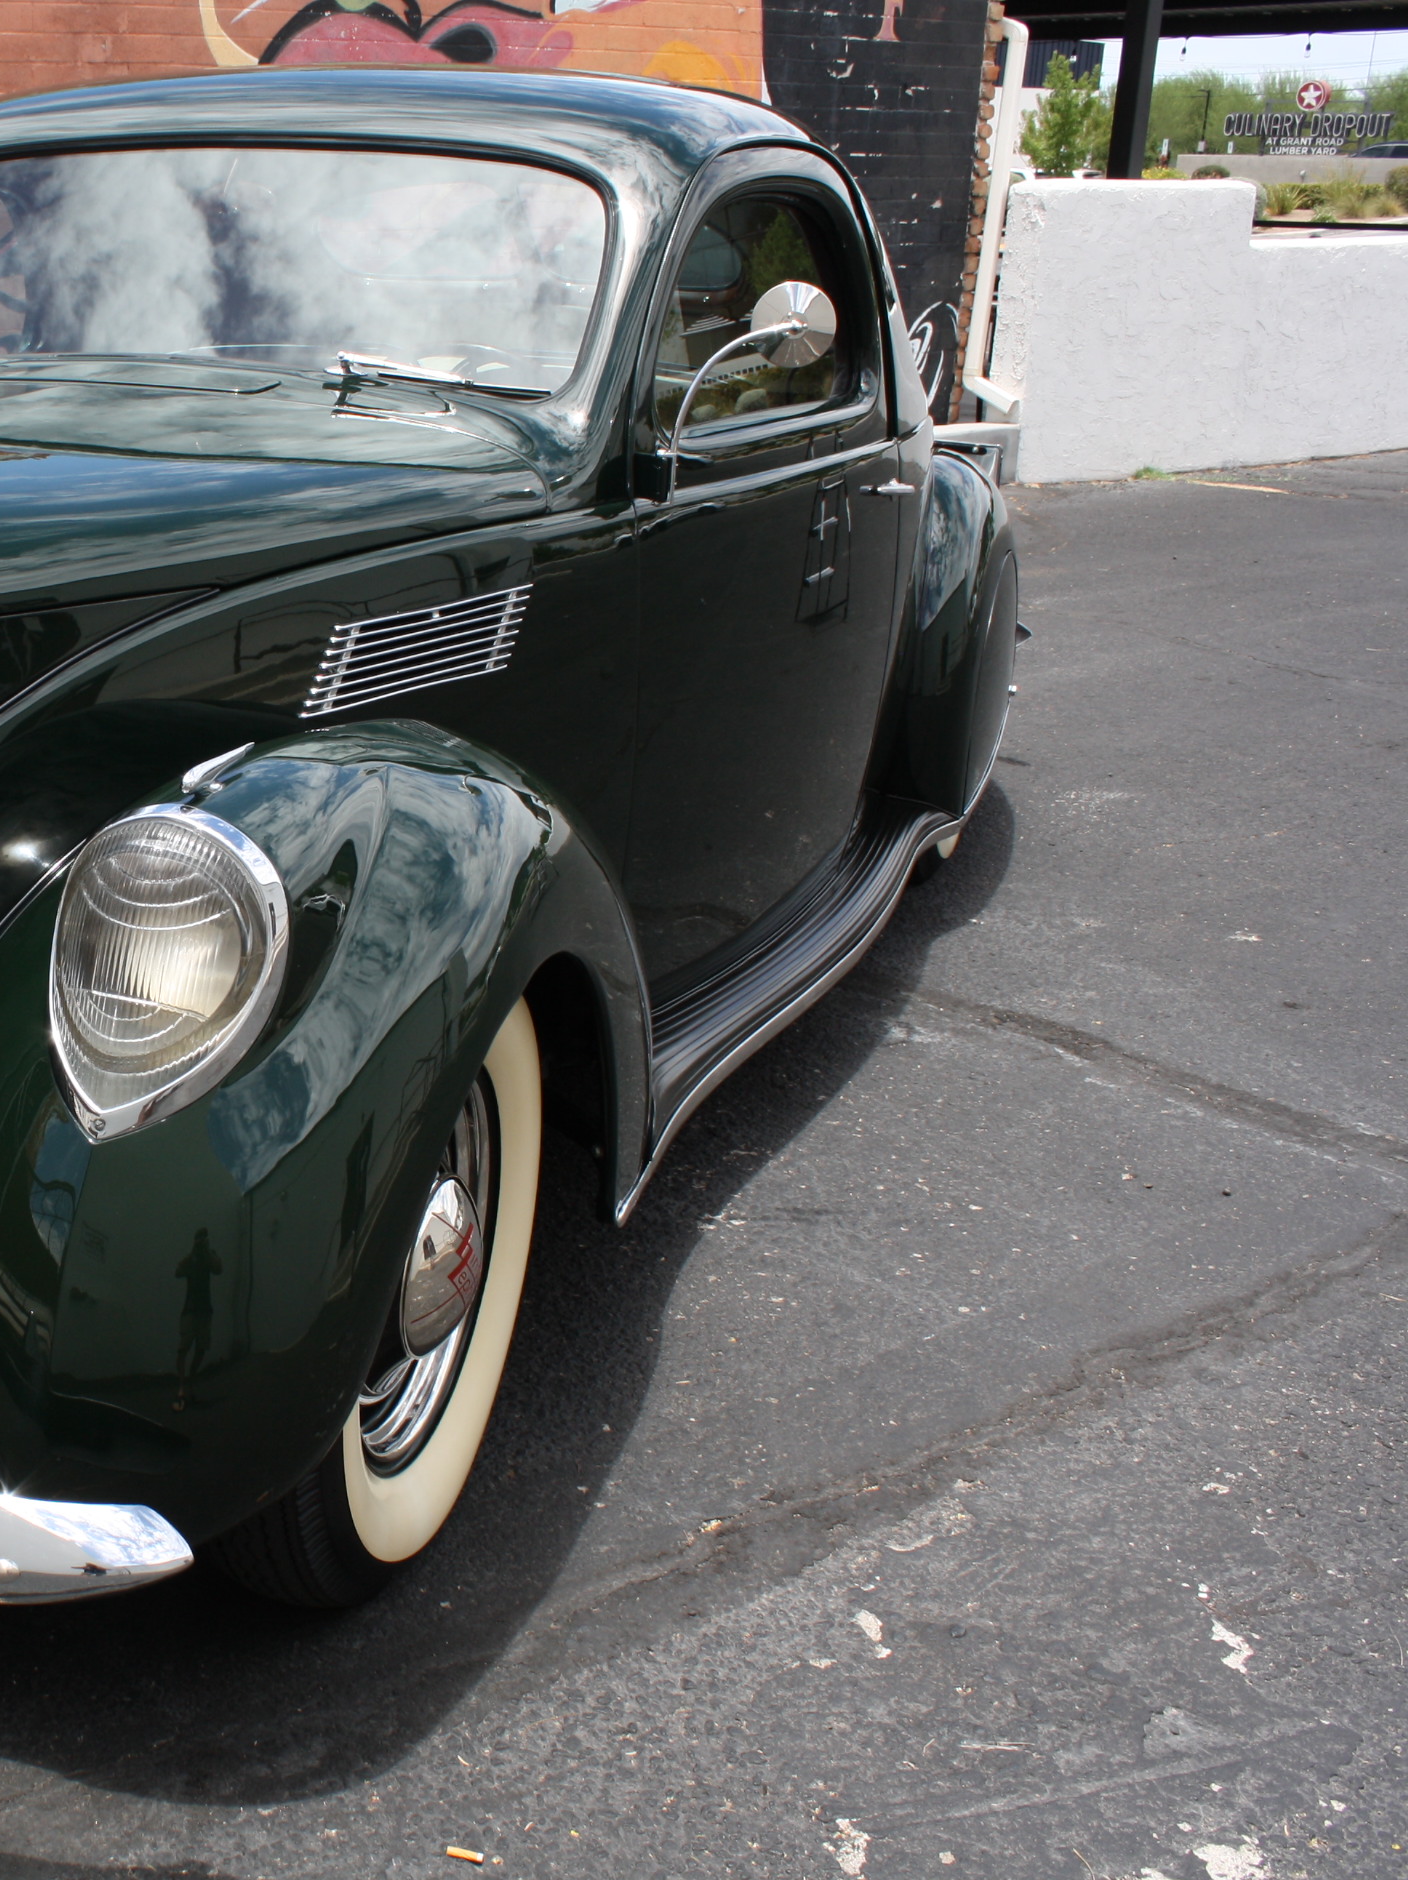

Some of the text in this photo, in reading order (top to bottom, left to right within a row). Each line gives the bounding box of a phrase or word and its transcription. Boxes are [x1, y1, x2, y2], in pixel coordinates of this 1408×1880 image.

[1223, 112, 1393, 138] CULINARY DROPOUT
[1265, 137, 1344, 146] AT GRANT ROAD
[1269, 146, 1337, 156] LUMBER YARD
